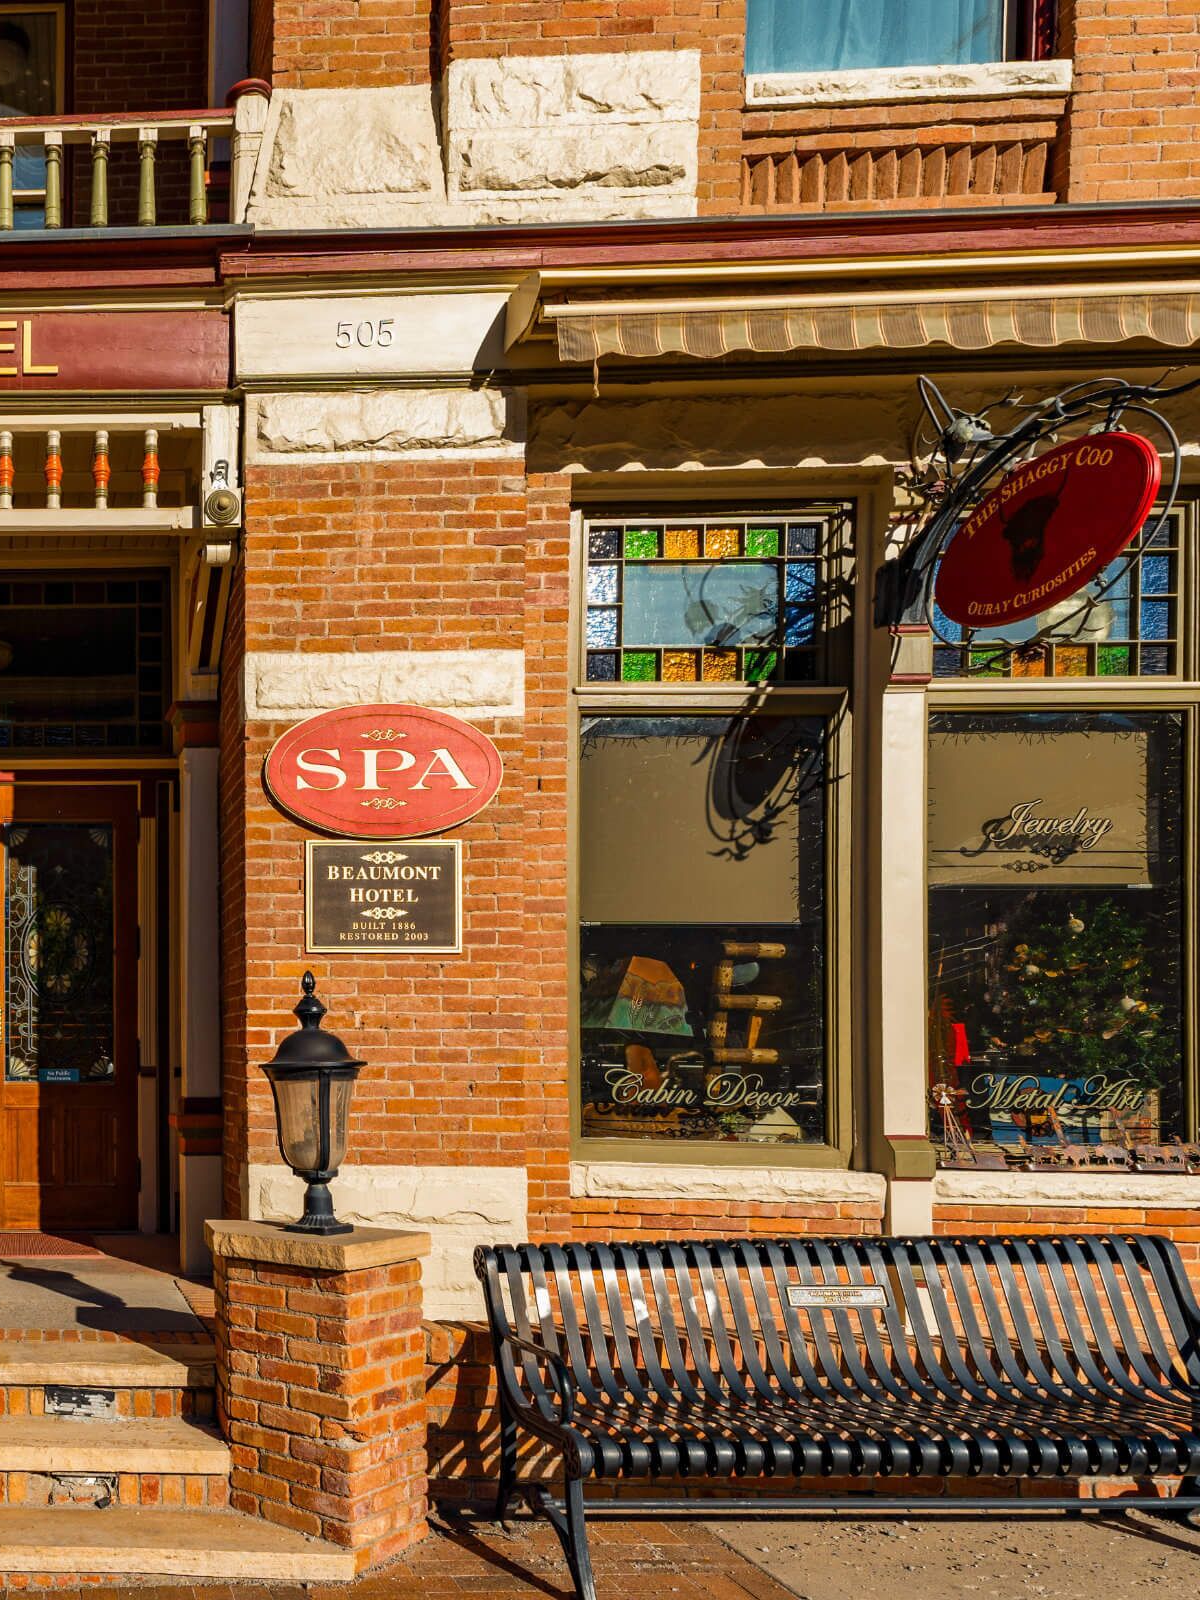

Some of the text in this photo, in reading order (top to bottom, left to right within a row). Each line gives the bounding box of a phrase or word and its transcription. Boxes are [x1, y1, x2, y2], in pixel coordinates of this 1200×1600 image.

[335, 318, 395, 349] 505
[964, 501, 999, 538] THE
[1001, 452, 1073, 501] SHAGGY
[967, 546, 1097, 616] OURAY CURIOSITIES
[296, 748, 478, 791] SPA
[988, 799, 1113, 850] Jewelry
[327, 866, 442, 881] BEAUMONT
[349, 888, 420, 904] HOTEL
[339, 932, 430, 942] RESTORED 2003
[352, 921, 417, 931] BUILT 1886
[604, 1068, 697, 1105] Cabin
[966, 1074, 1147, 1110] Metal Art
